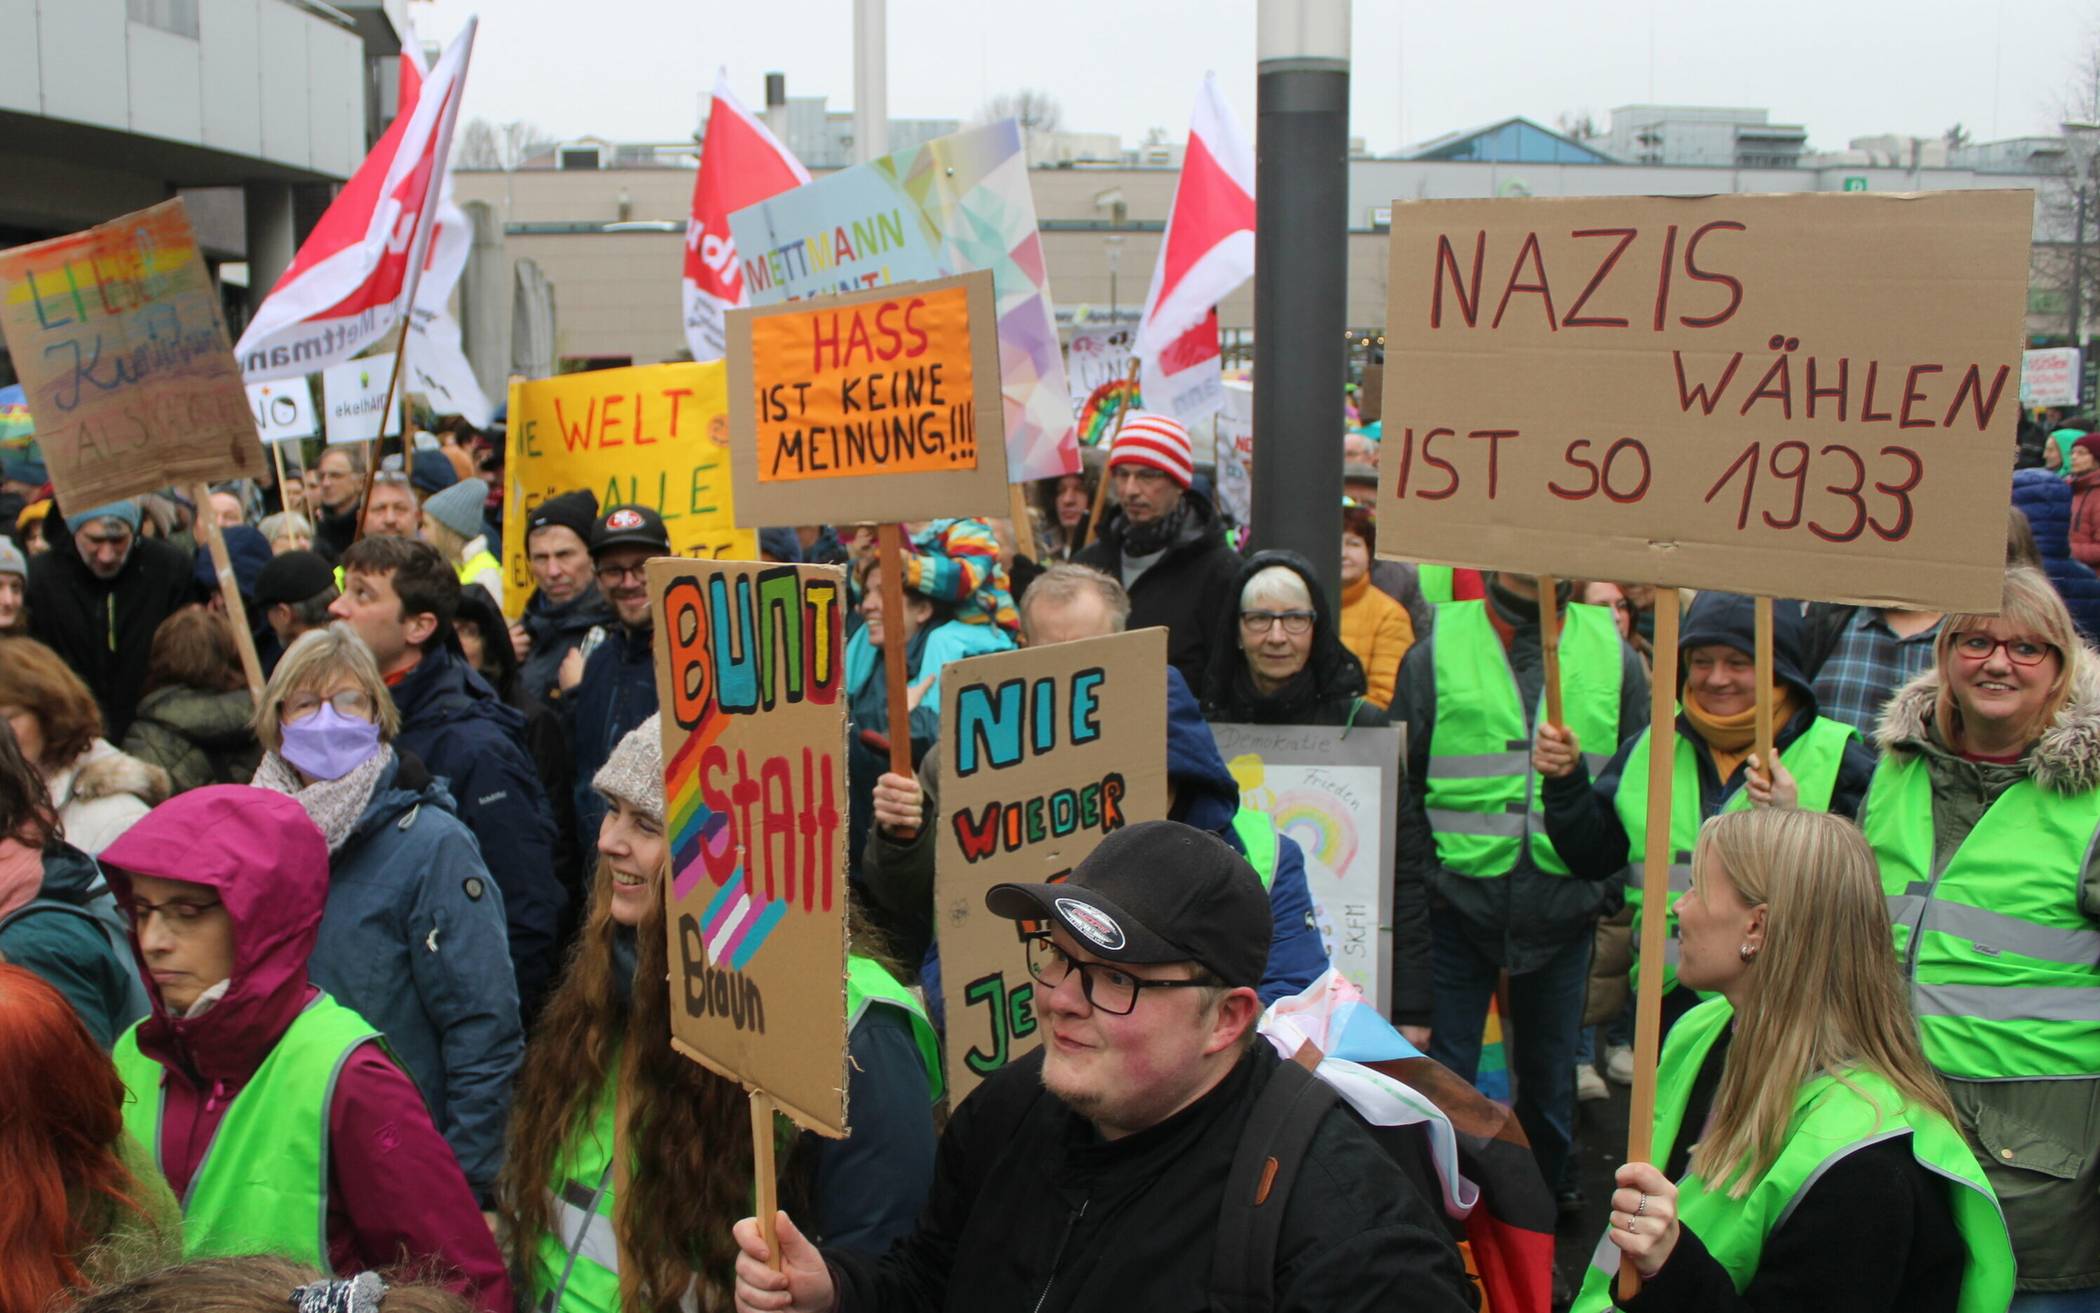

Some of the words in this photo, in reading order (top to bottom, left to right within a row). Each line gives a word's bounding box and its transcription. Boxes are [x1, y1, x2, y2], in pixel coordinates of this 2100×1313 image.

[745, 208, 905, 294] METTMANN
[1431, 220, 1746, 331] NAZIS
[814, 298, 928, 374] HASS
[555, 388, 694, 453] WELT
[761, 382, 812, 423] IST
[842, 363, 945, 415] KEINE
[1673, 334, 2010, 431] WÄHLEN
[772, 401, 975, 476] MEINUNG!!!
[1397, 427, 1520, 500] IST
[1548, 437, 1650, 503] SO
[1705, 441, 1923, 543] 1933
[955, 667, 1105, 777] NIE
[1216, 727, 1332, 752] Demokratie
[953, 772, 1125, 863] WIEDER
[1302, 767, 1361, 812] Frieden
[679, 912, 766, 1034] Braun
